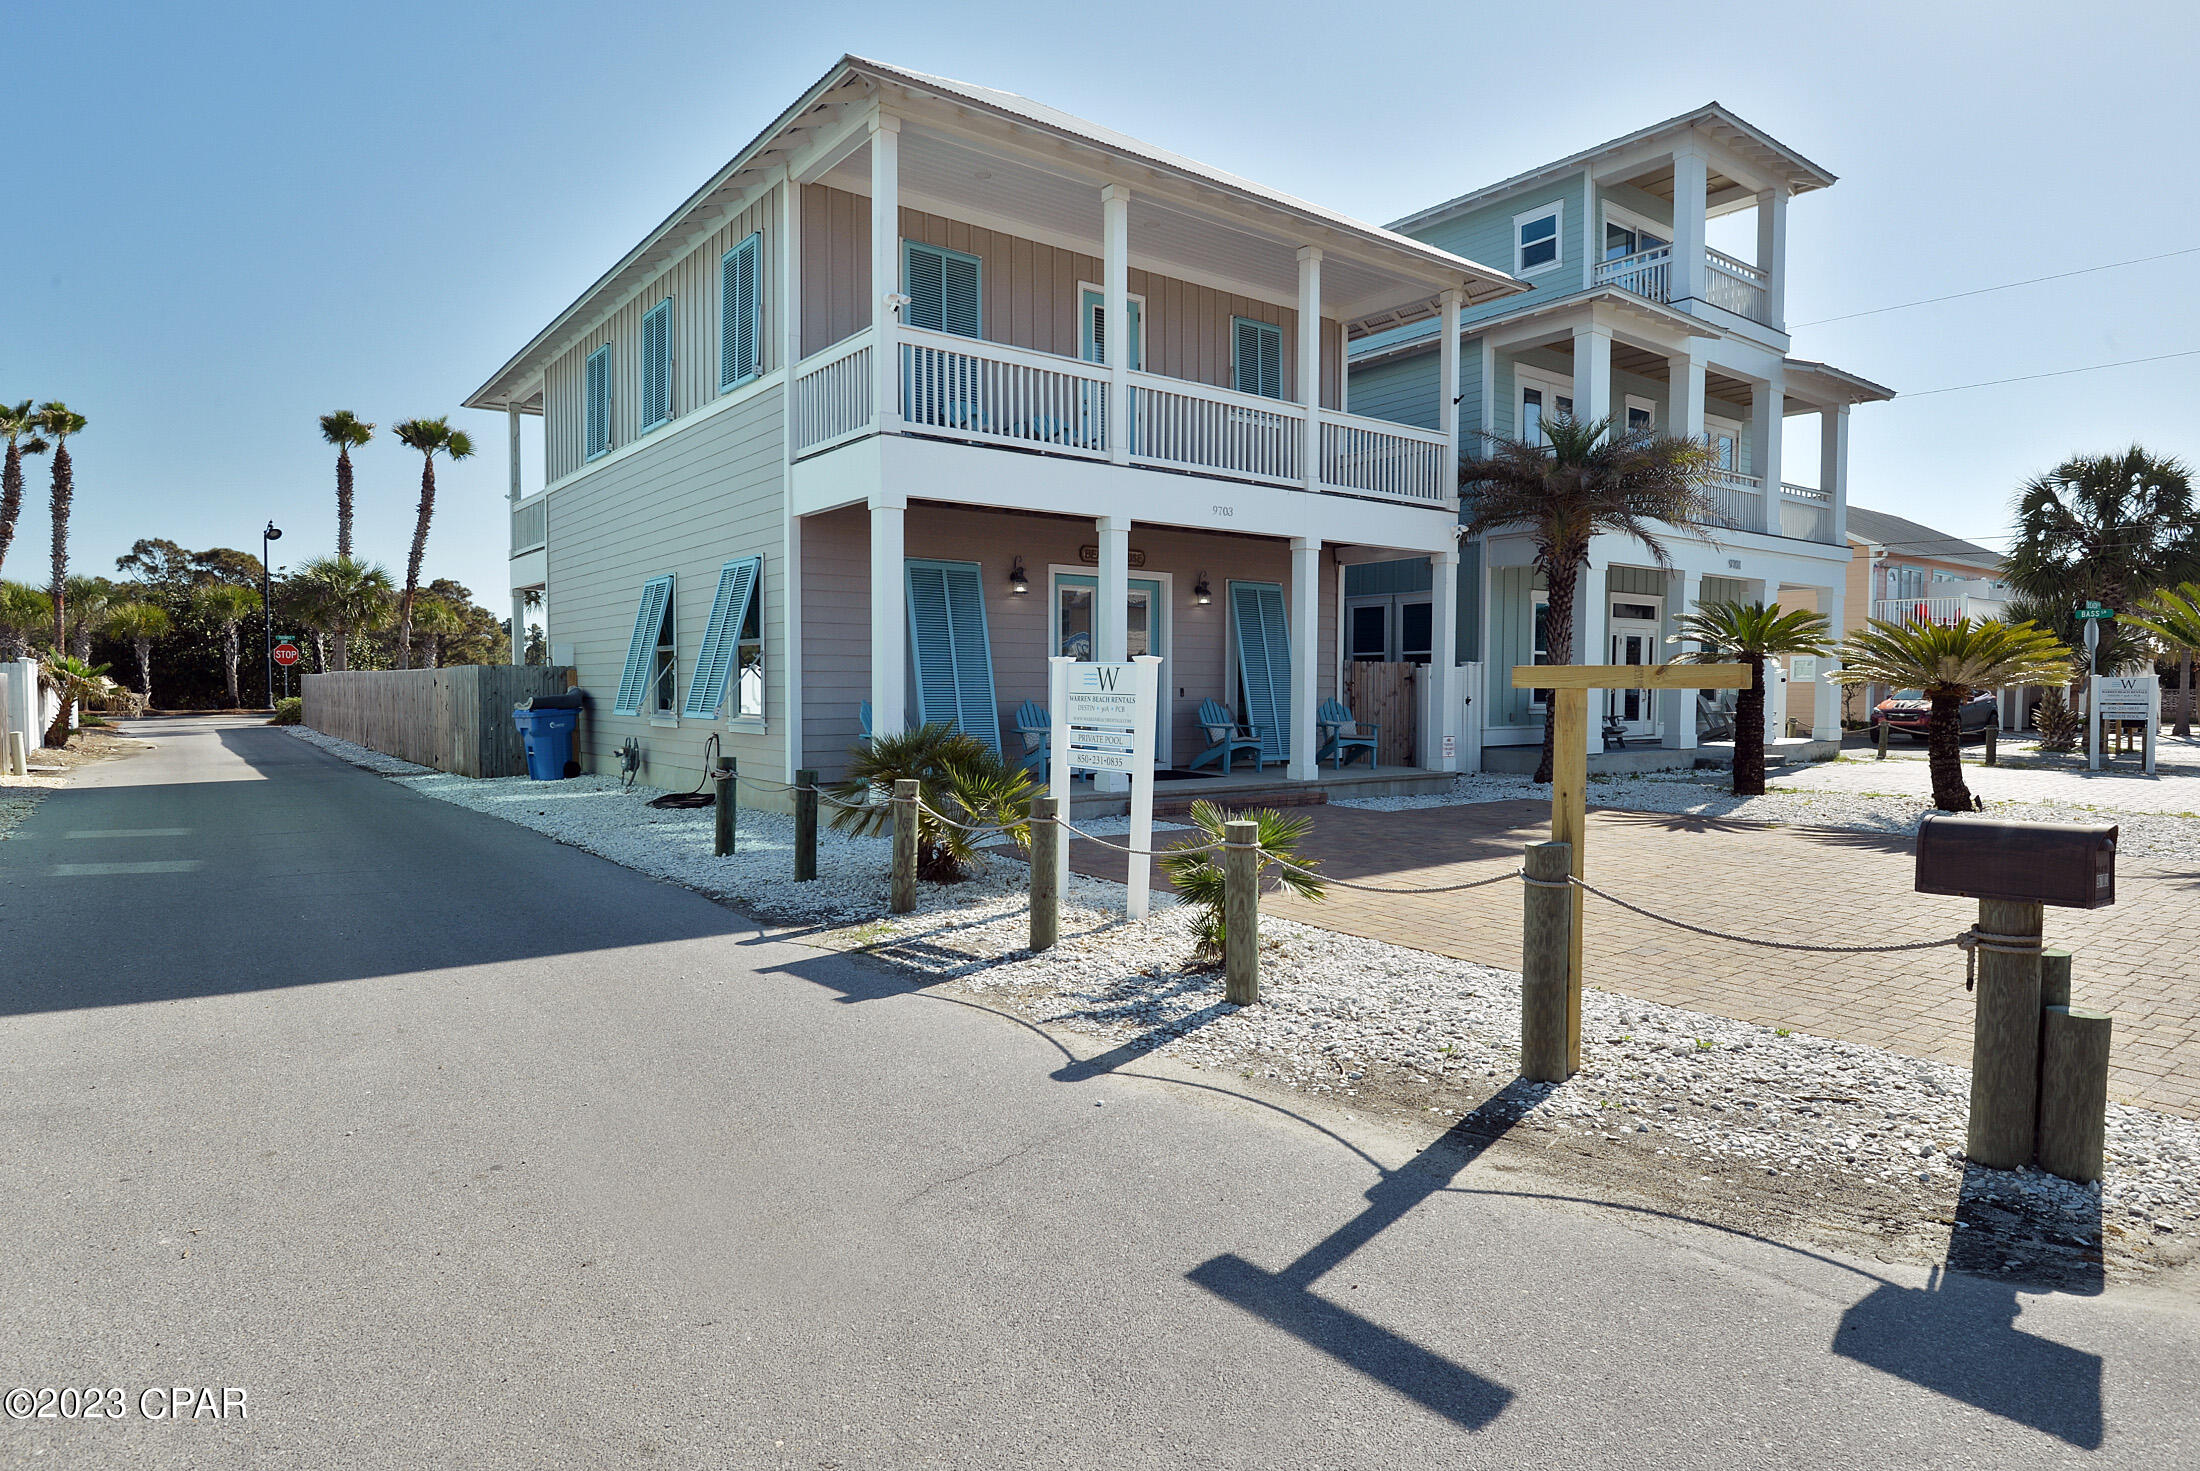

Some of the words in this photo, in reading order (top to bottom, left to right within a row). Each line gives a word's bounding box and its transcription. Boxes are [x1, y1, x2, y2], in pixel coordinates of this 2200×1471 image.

[1212, 505, 1234, 517] 9703
[2081, 610, 2100, 618] BASS
[275, 650, 297, 659] STOP
[1096, 666, 1120, 692] W
[2121, 679, 2136, 690] W
[1111, 696, 1136, 704] RENTALS
[1114, 705, 1126, 713] PCB
[1078, 734, 1104, 744] PRIVATE
[1104, 735, 1123, 745] POOL
